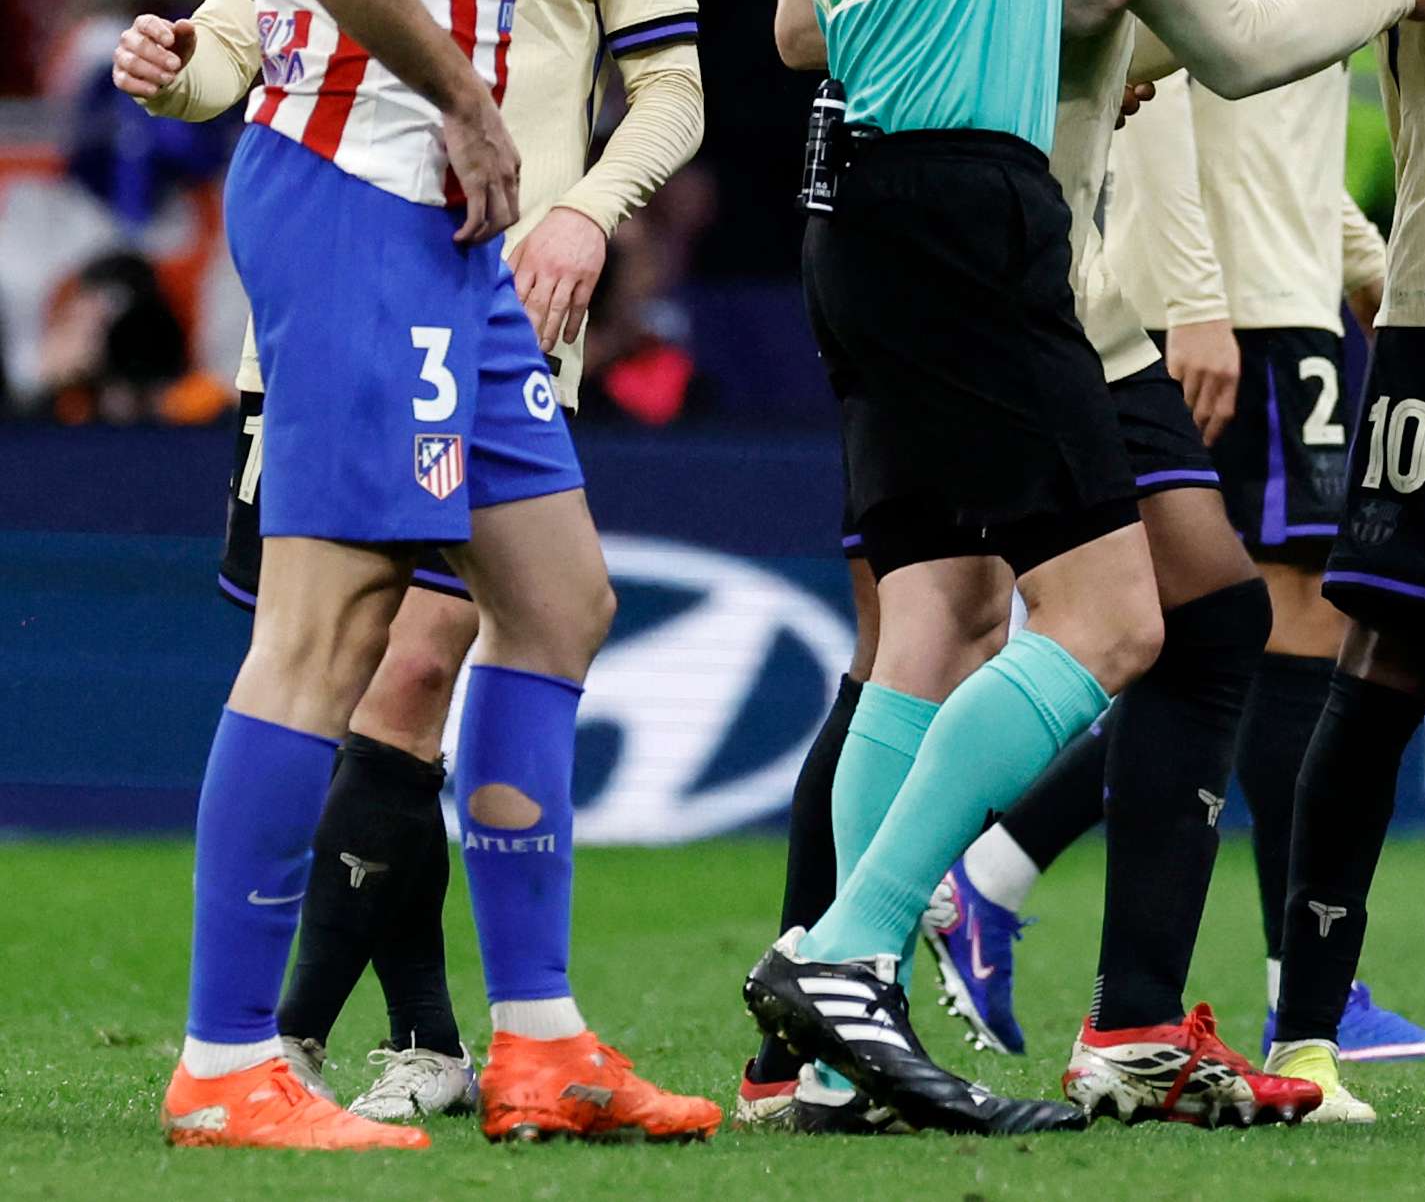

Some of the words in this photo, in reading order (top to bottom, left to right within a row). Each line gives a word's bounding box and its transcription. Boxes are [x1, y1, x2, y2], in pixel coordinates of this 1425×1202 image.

[411, 325, 458, 423] 3
[1298, 355, 1346, 446] 2
[464, 831, 555, 853] ATLETI
